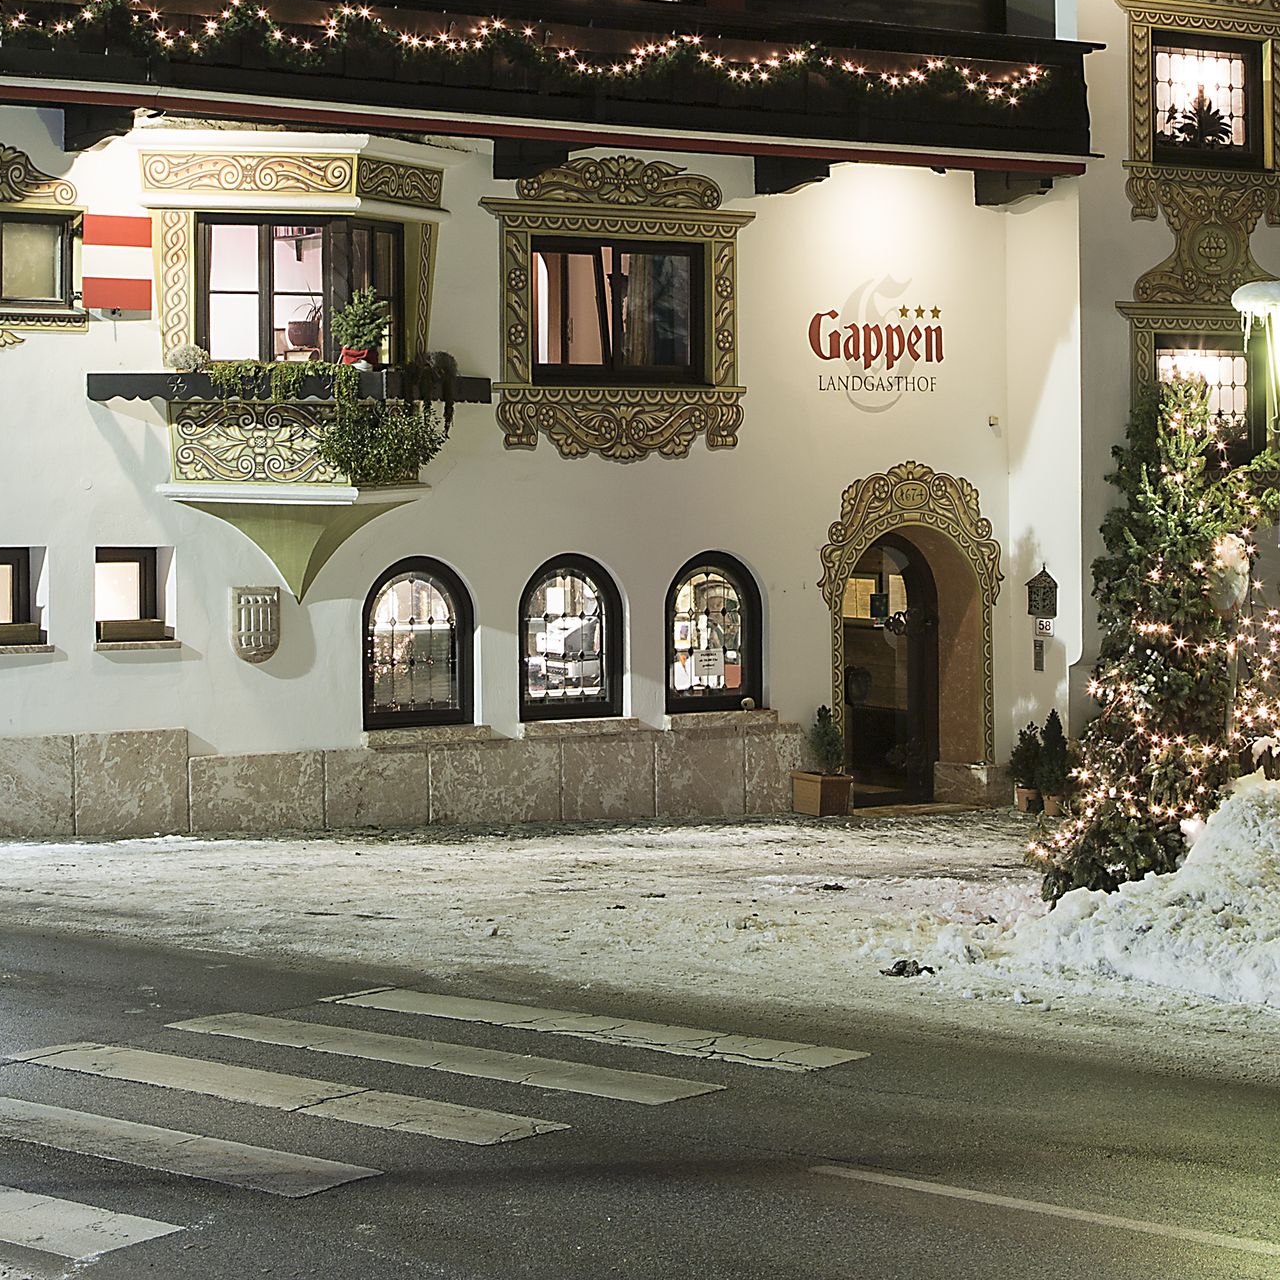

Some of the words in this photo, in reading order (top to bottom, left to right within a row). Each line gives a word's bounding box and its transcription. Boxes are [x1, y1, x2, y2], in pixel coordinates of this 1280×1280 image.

[808, 309, 944, 371] Gappen
[818, 375, 937, 392] LANDGASTHOF
[1039, 620, 1051, 631] 58
